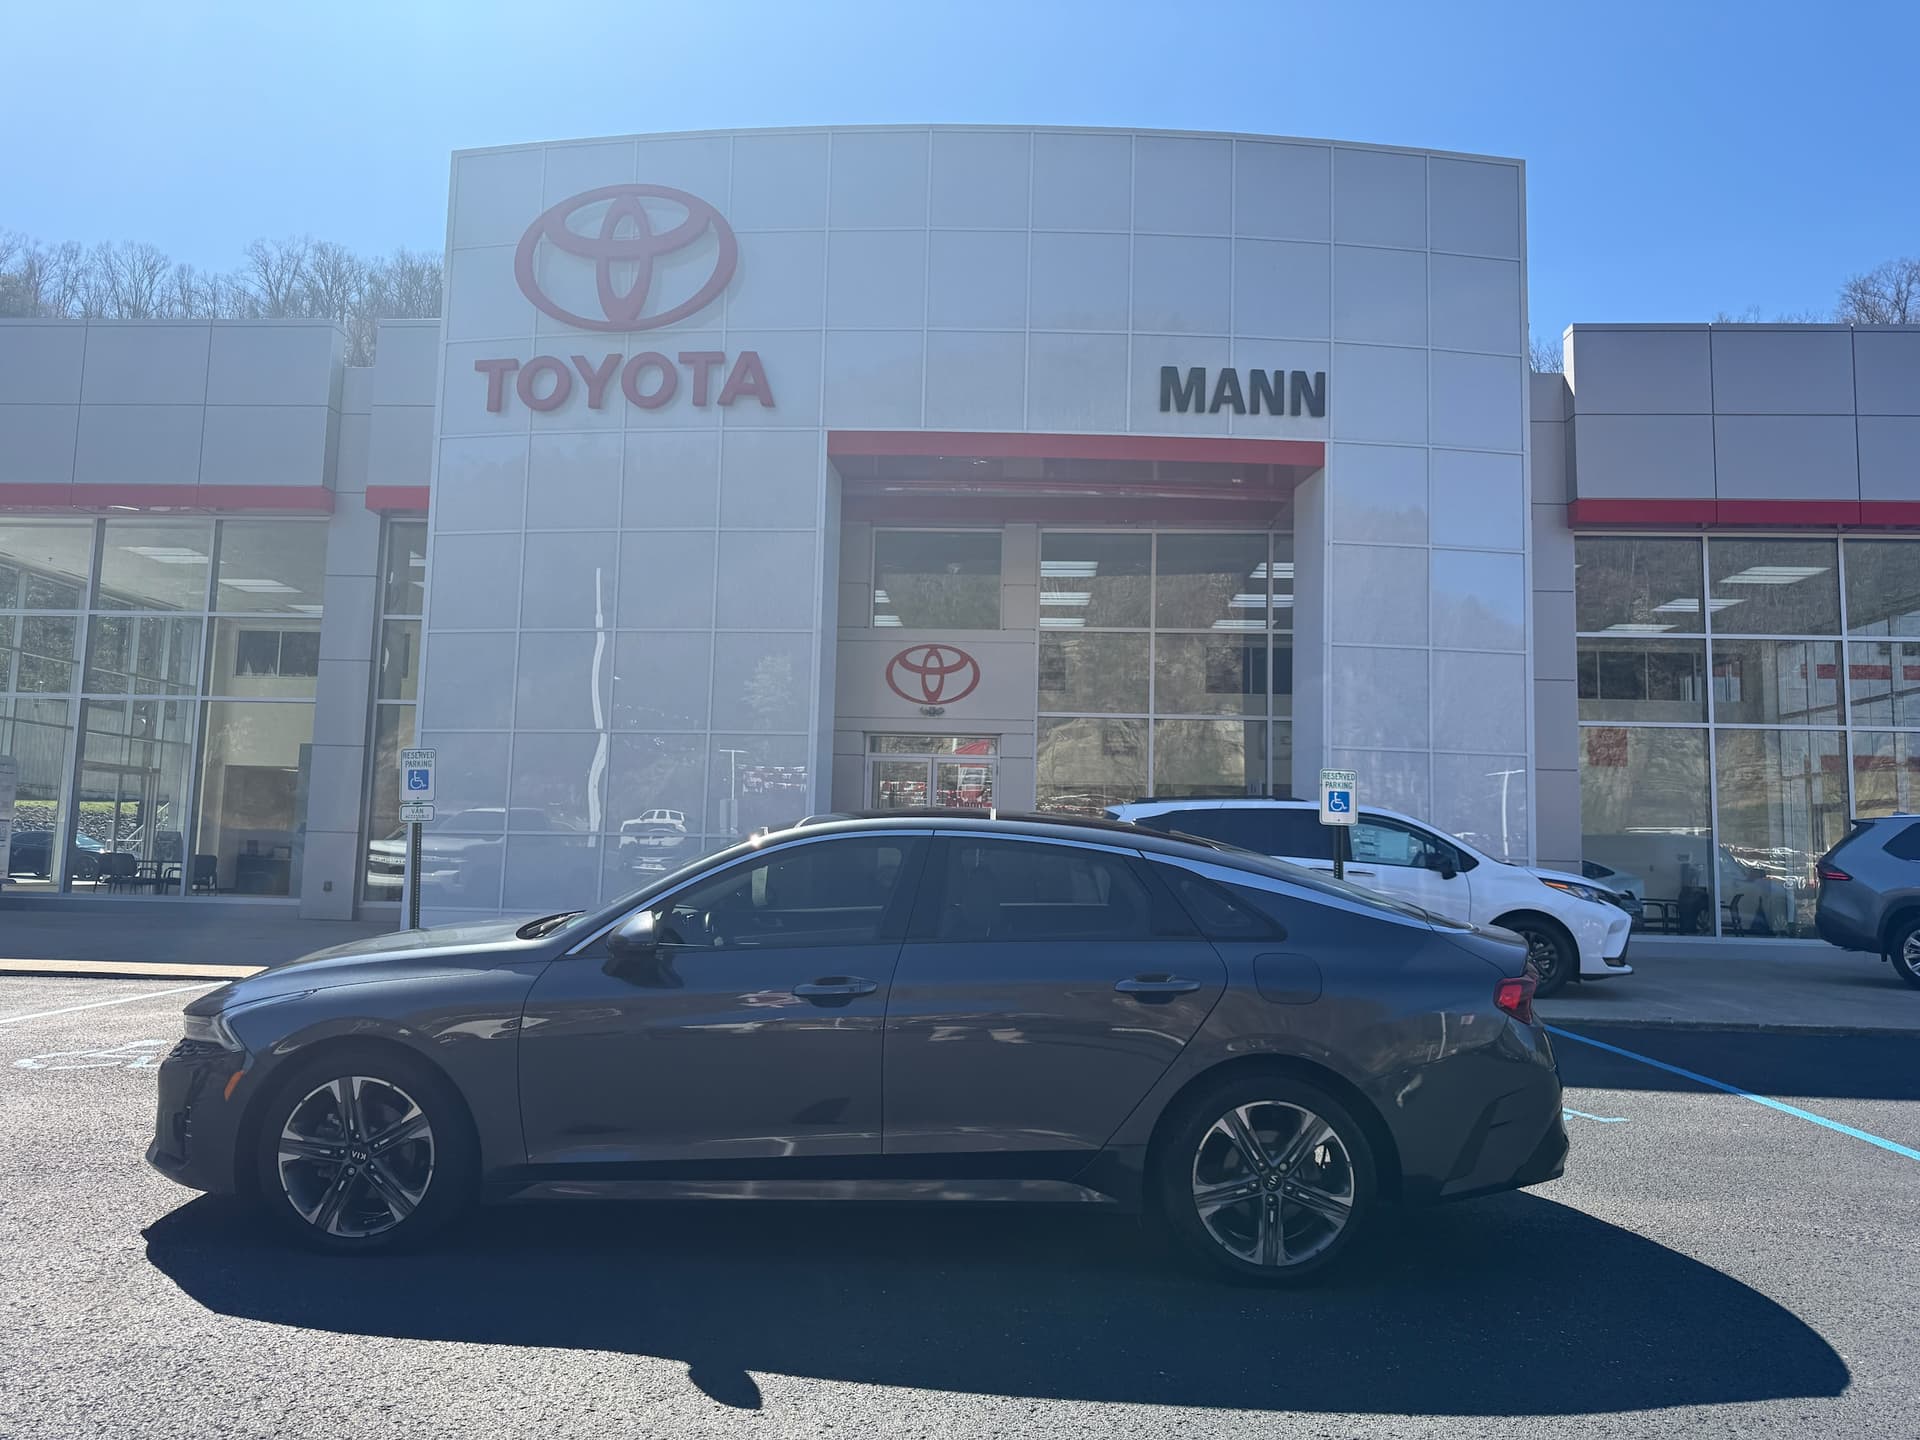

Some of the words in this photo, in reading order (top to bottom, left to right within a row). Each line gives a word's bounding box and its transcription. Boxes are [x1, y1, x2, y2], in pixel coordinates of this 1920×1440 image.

[474, 350, 776, 412] TOYOTA
[1160, 366, 1326, 418] MANN
[402, 751, 435, 760] RESERVED
[405, 760, 432, 768] PARKING
[1322, 772, 1355, 781] RESERVED
[1325, 781, 1353, 790] PARKING
